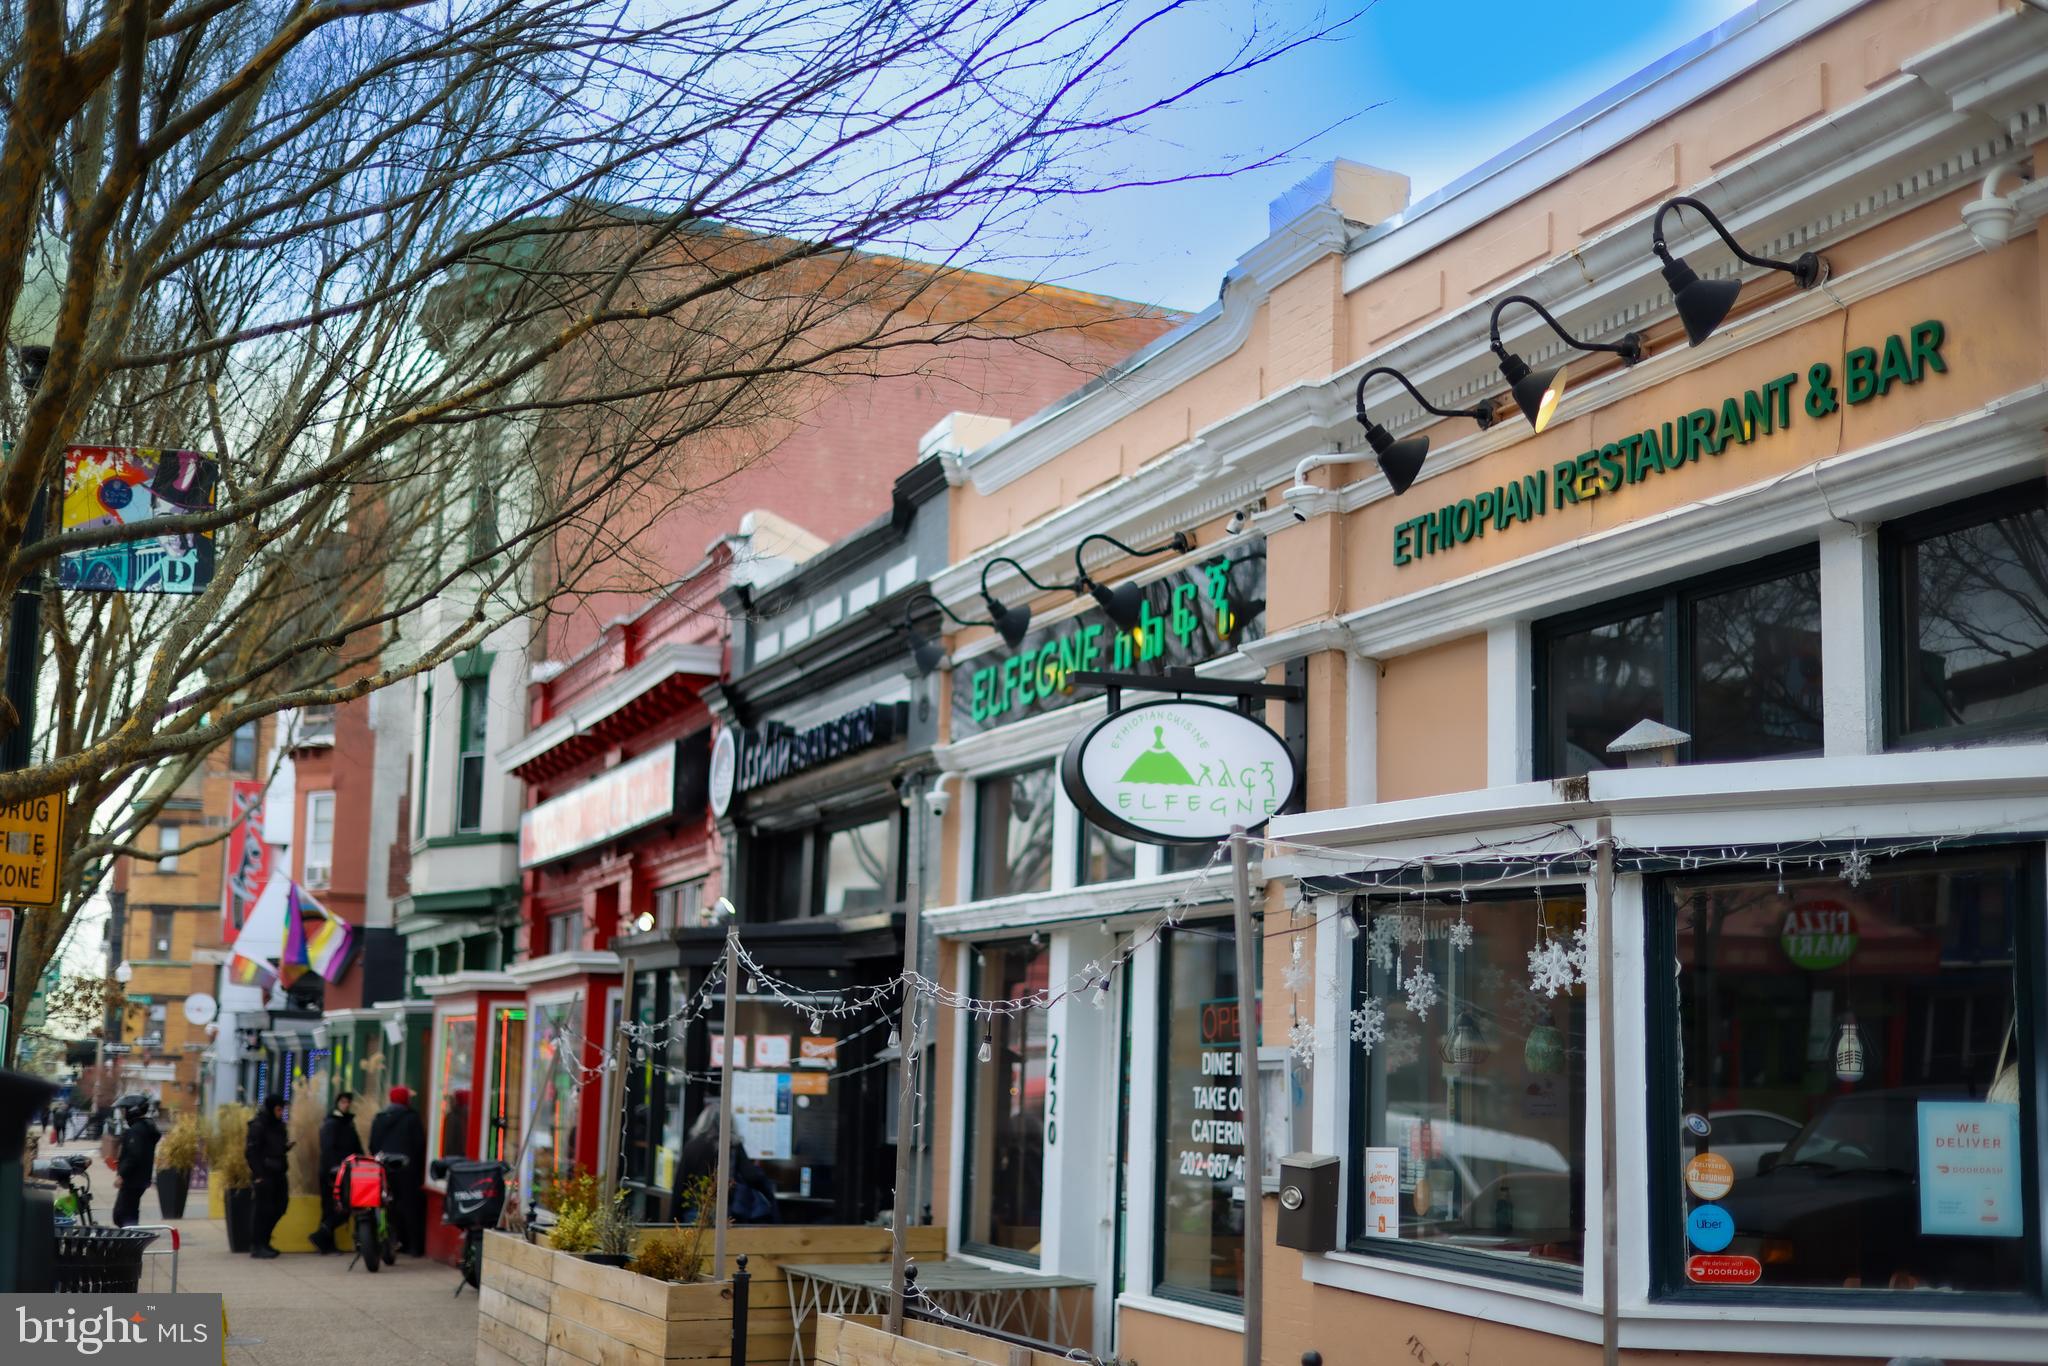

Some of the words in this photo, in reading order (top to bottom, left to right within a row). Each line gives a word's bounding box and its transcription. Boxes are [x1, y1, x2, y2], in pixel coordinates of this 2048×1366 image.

[1392, 469, 1546, 566] ETHIOPIAN
[1552, 371, 1798, 505] RESTAURANT
[1804, 361, 1840, 418] &
[1845, 319, 1947, 406] BAR
[970, 623, 1104, 723] ELFEGNE
[1111, 711, 1165, 750] ETHIOPIAN
[1166, 711, 1210, 750] CUISINE
[0, 799, 48, 823] RUG
[1117, 792, 1277, 817] ELFEGNE
[0, 864, 41, 888] ONE
[1203, 1005, 1241, 1040] OPE
[1202, 1052, 1233, 1076] DINE
[1047, 1033, 1060, 1146] 2420
[1193, 1087, 1227, 1111] TAKE
[1229, 1087, 1244, 1112] OU
[1191, 1119, 1245, 1146] CATERIN
[1956, 1123, 1980, 1134] WE
[1936, 1137, 2001, 1149] DELIVER
[1180, 1151, 1245, 1181] 202-667-4
[1369, 1171, 1395, 1186] delivery
[1696, 1219, 1722, 1229] Uber
[1707, 1268, 1755, 1276] DOORDASH
